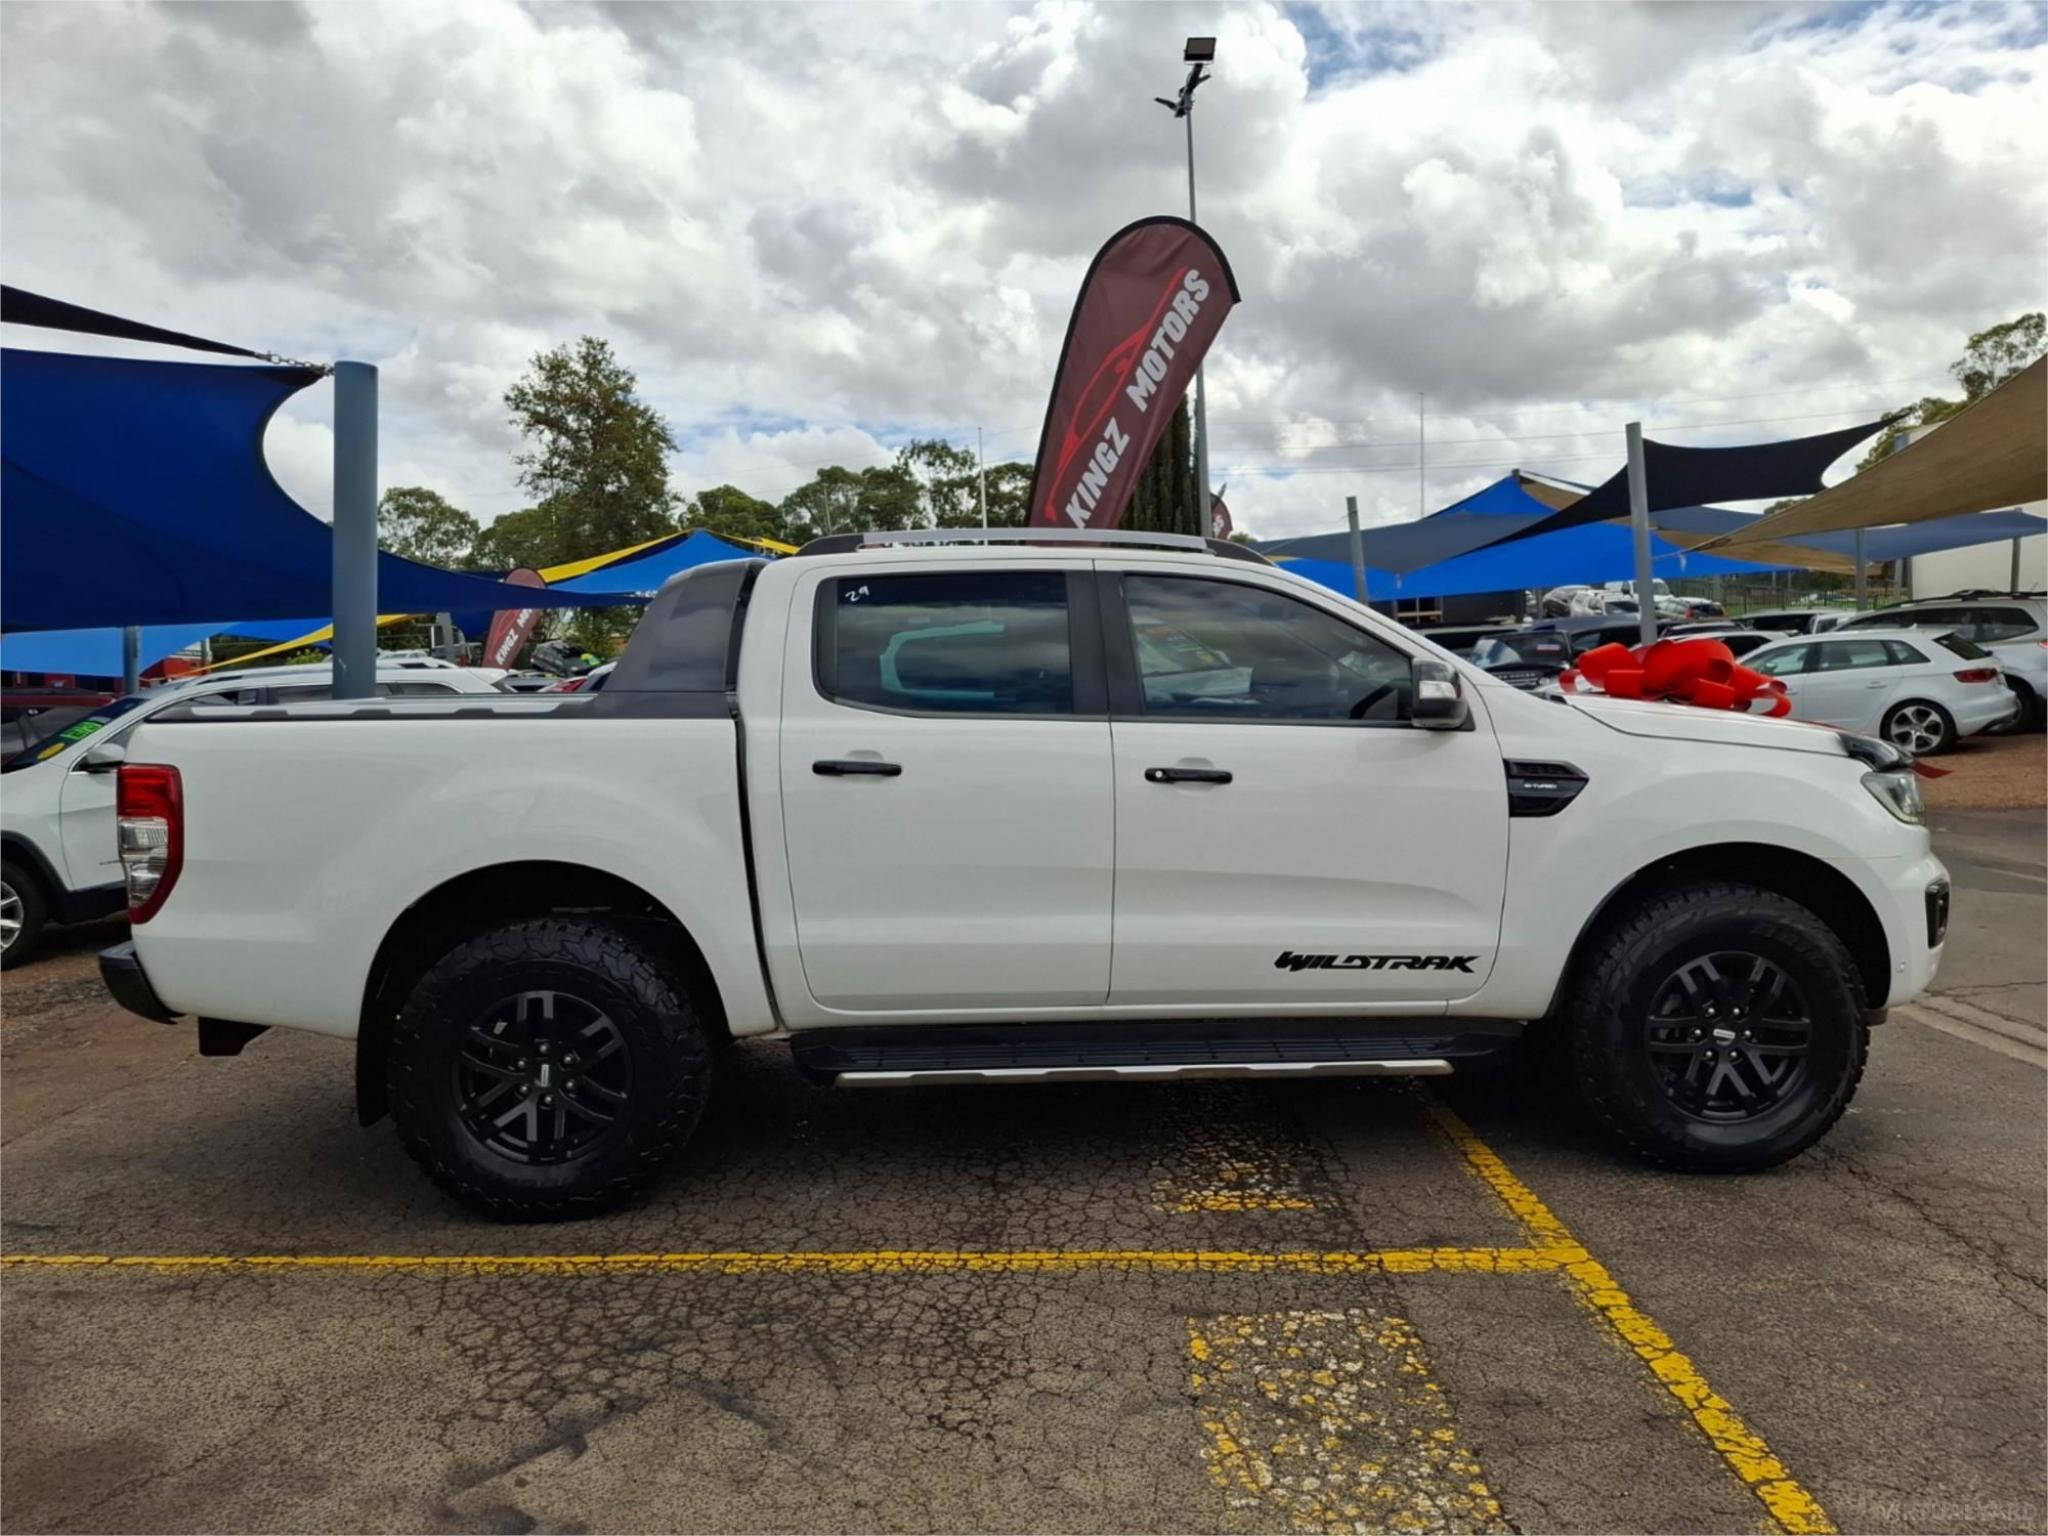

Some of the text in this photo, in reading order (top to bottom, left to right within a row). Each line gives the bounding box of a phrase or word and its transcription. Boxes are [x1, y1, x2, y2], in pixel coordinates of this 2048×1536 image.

[1066, 269, 1210, 529] KINGZ MOTORS
[496, 628, 519, 665] KINGZ
[1274, 951, 1480, 973] WILDTRAK
